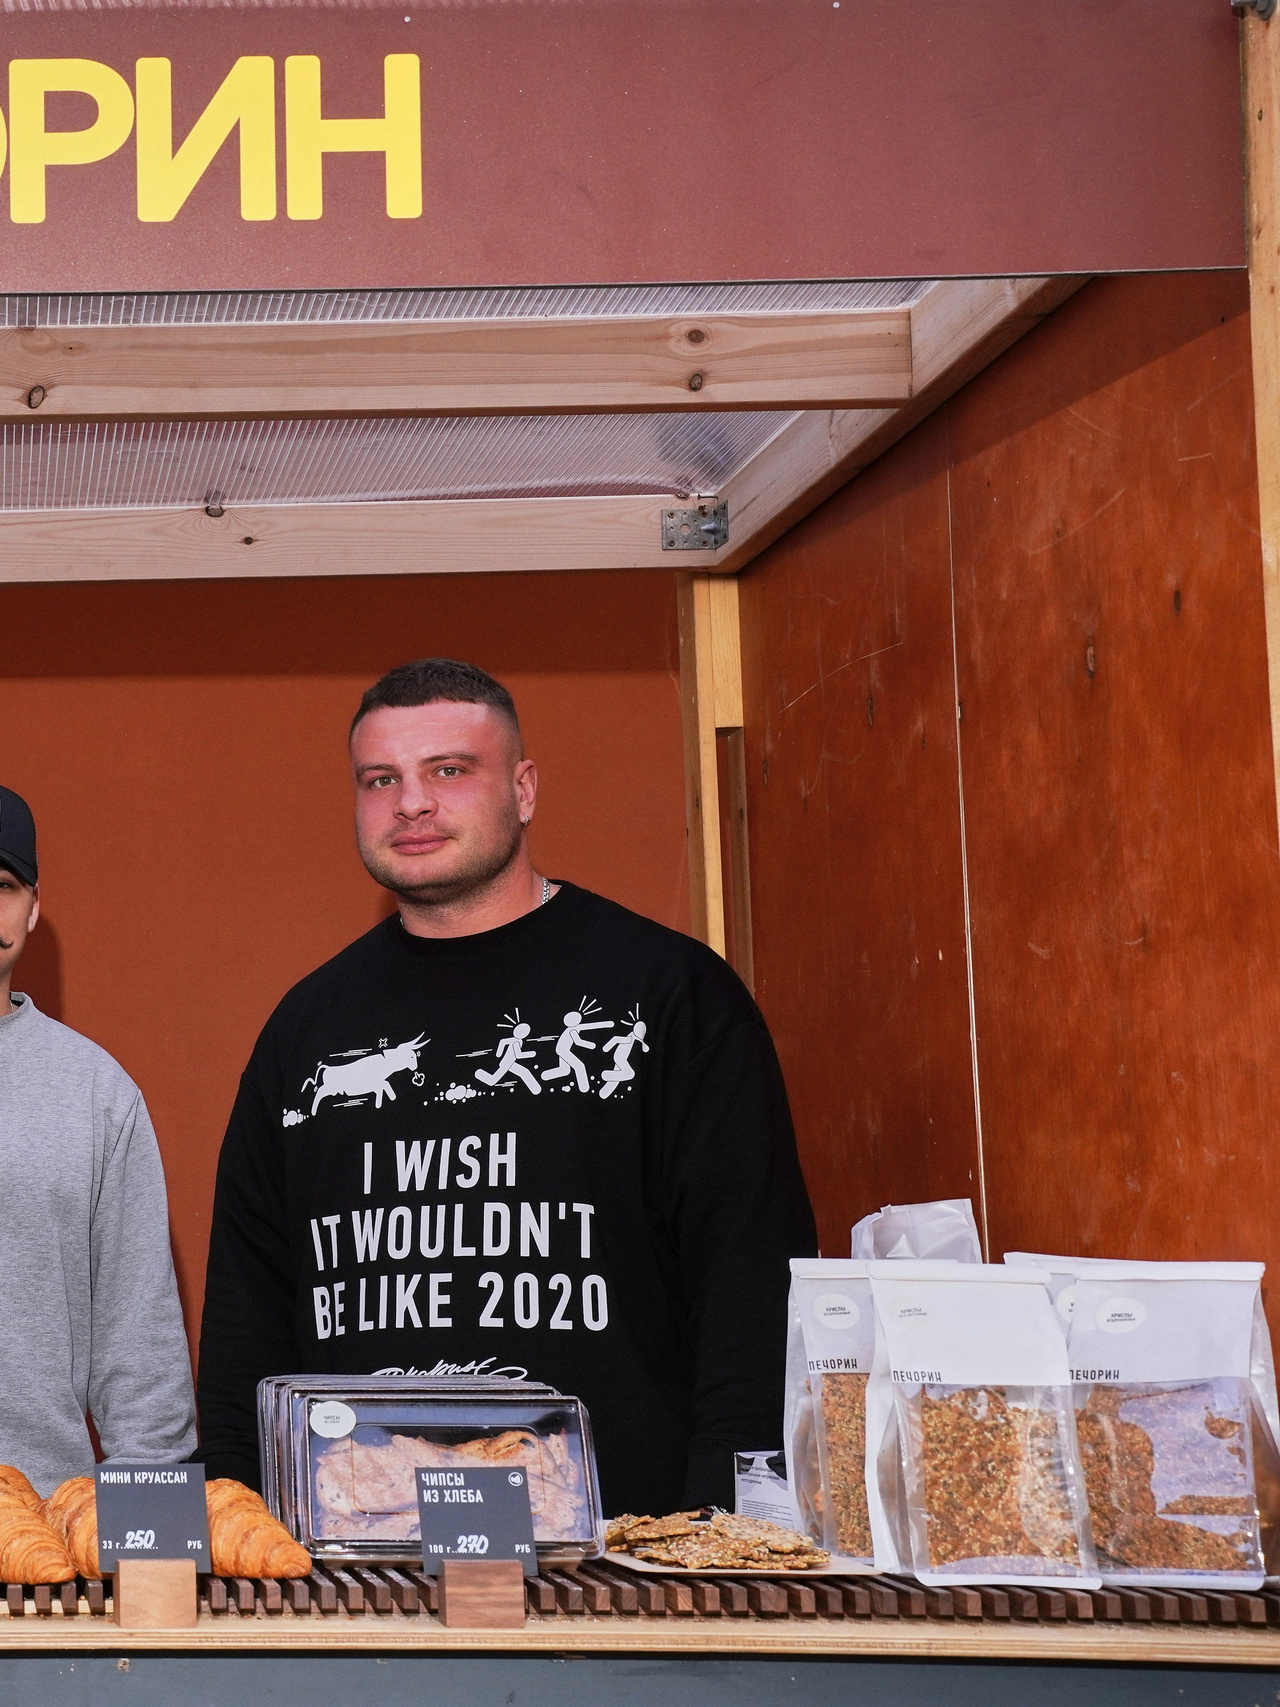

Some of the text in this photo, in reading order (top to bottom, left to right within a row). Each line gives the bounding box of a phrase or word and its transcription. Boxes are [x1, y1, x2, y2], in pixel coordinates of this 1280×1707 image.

[363, 1132, 517, 1195] I WISH
[311, 1201, 596, 1271] IT WOULDN'T
[313, 1271, 609, 1340] BE LIKE 2020
[808, 1358, 858, 1371] ПЕЧОРИН
[892, 1370, 942, 1382] ПЕЧОРИН
[100, 1471, 188, 1484] МИНИ КРУАССАН
[421, 1472, 465, 1486] ЧИПСЫ
[423, 1489, 484, 1503] ИЗ ХЛЕБА
[102, 1540, 113, 1550] 33
[187, 1540, 203, 1550] РУБ
[428, 1544, 444, 1553] 100
[515, 1544, 531, 1553] РУБ
